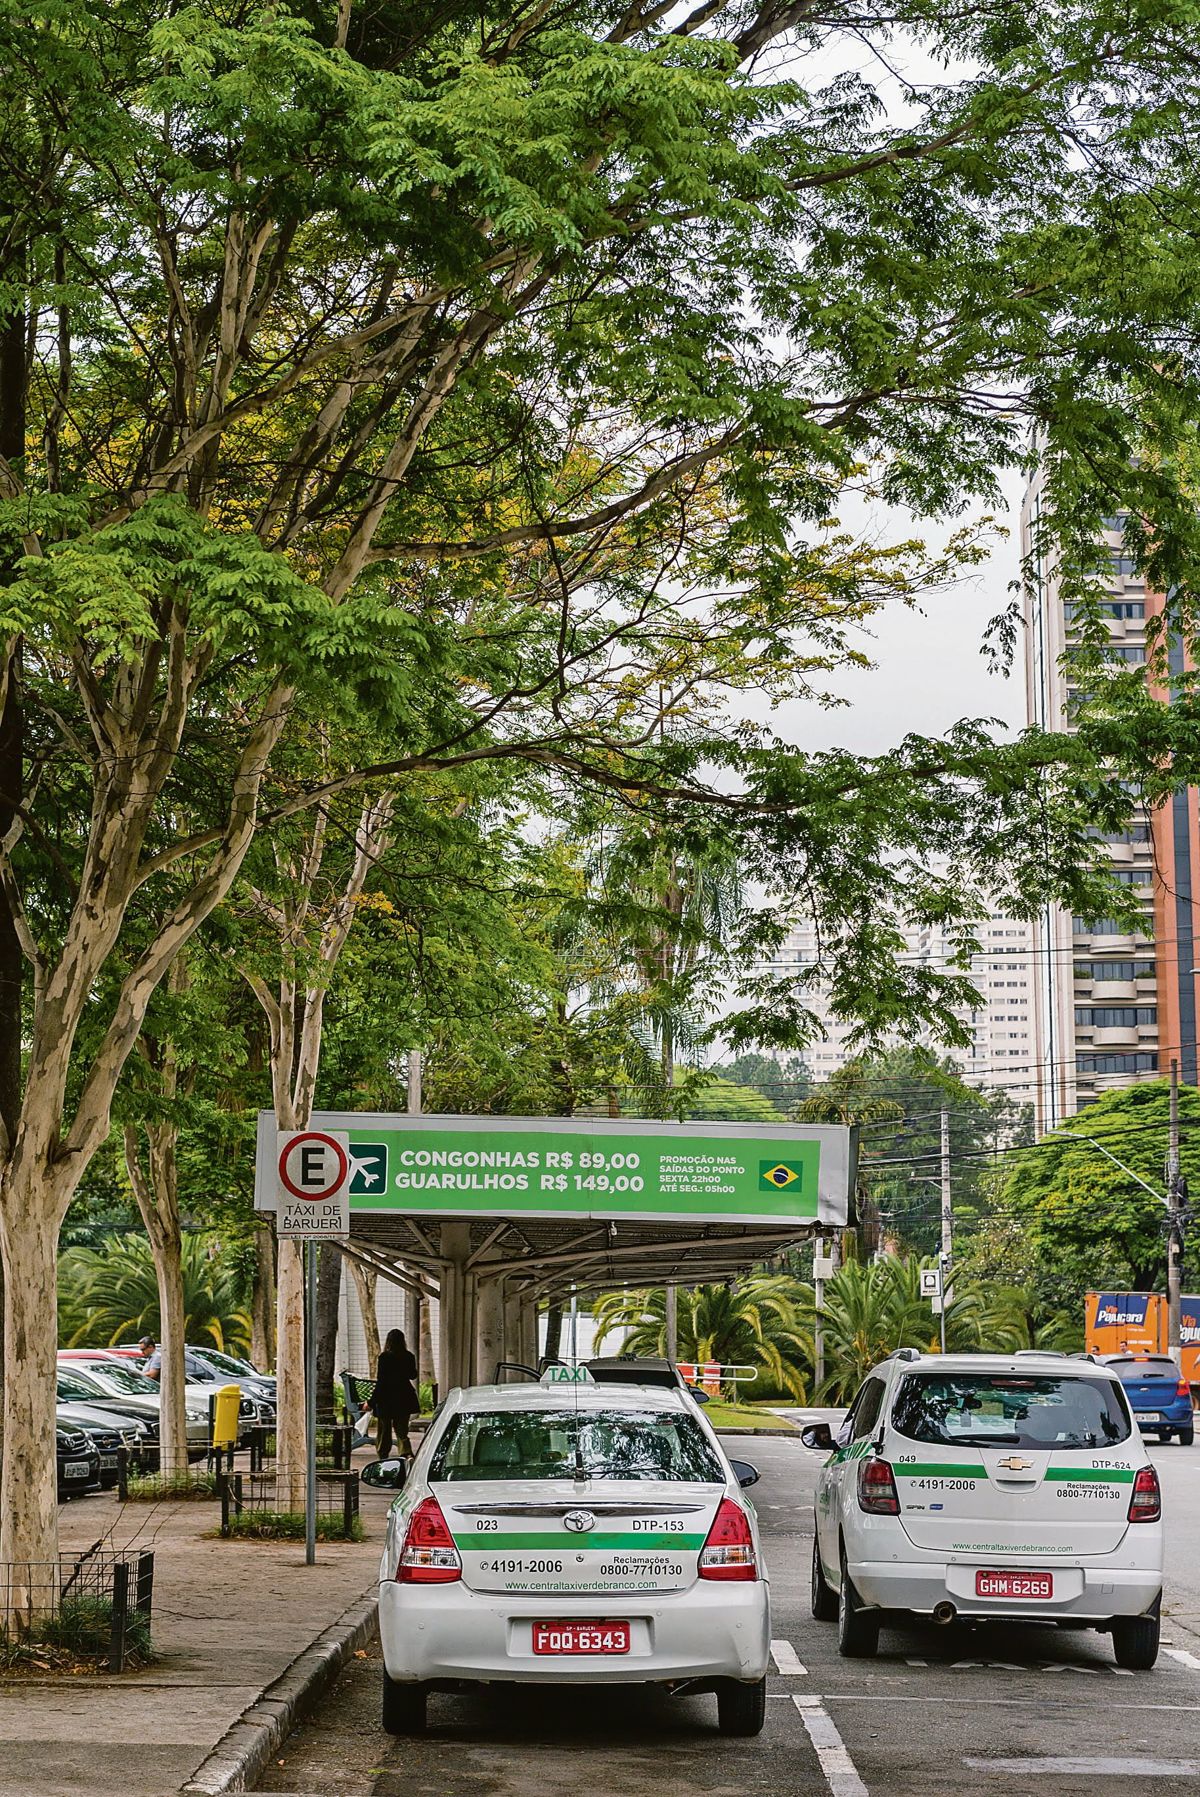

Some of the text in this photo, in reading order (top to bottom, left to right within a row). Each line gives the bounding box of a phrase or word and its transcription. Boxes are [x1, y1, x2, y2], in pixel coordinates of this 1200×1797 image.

[400, 1150, 640, 1172] CONGONHAS R$ 89,00
[659, 1154, 737, 1166] PROMOÇÃO NAS
[301, 1147, 325, 1186] E
[659, 1163, 745, 1174] SAÍDAS DO PONTO
[395, 1173, 644, 1194] GUARULHOS R$ 149,00
[659, 1175, 721, 1184] SEXTA 22h00
[659, 1182, 735, 1194] ATÉ SEG.: 05h00
[286, 1203, 341, 1216] TÁXI DE
[283, 1218, 342, 1229] BARUERI
[548, 1367, 587, 1382] TAXI
[899, 1455, 916, 1463] 049
[1092, 1459, 1131, 1470] DTP-624
[918, 1479, 976, 1491] 4191-2006
[1066, 1482, 1110, 1491] Reclamações
[1056, 1488, 1121, 1500] 0800-7710130
[476, 1520, 499, 1531] 023
[632, 1520, 685, 1531] DTP-153
[952, 1542, 1073, 1553] www.centraltaxiverdebranco.com
[613, 1556, 670, 1566] Reclamações
[491, 1560, 563, 1574] 4191-2006
[600, 1564, 683, 1576] 0800-7710130
[505, 1580, 658, 1590] www.centraltaxiverdebranco.com
